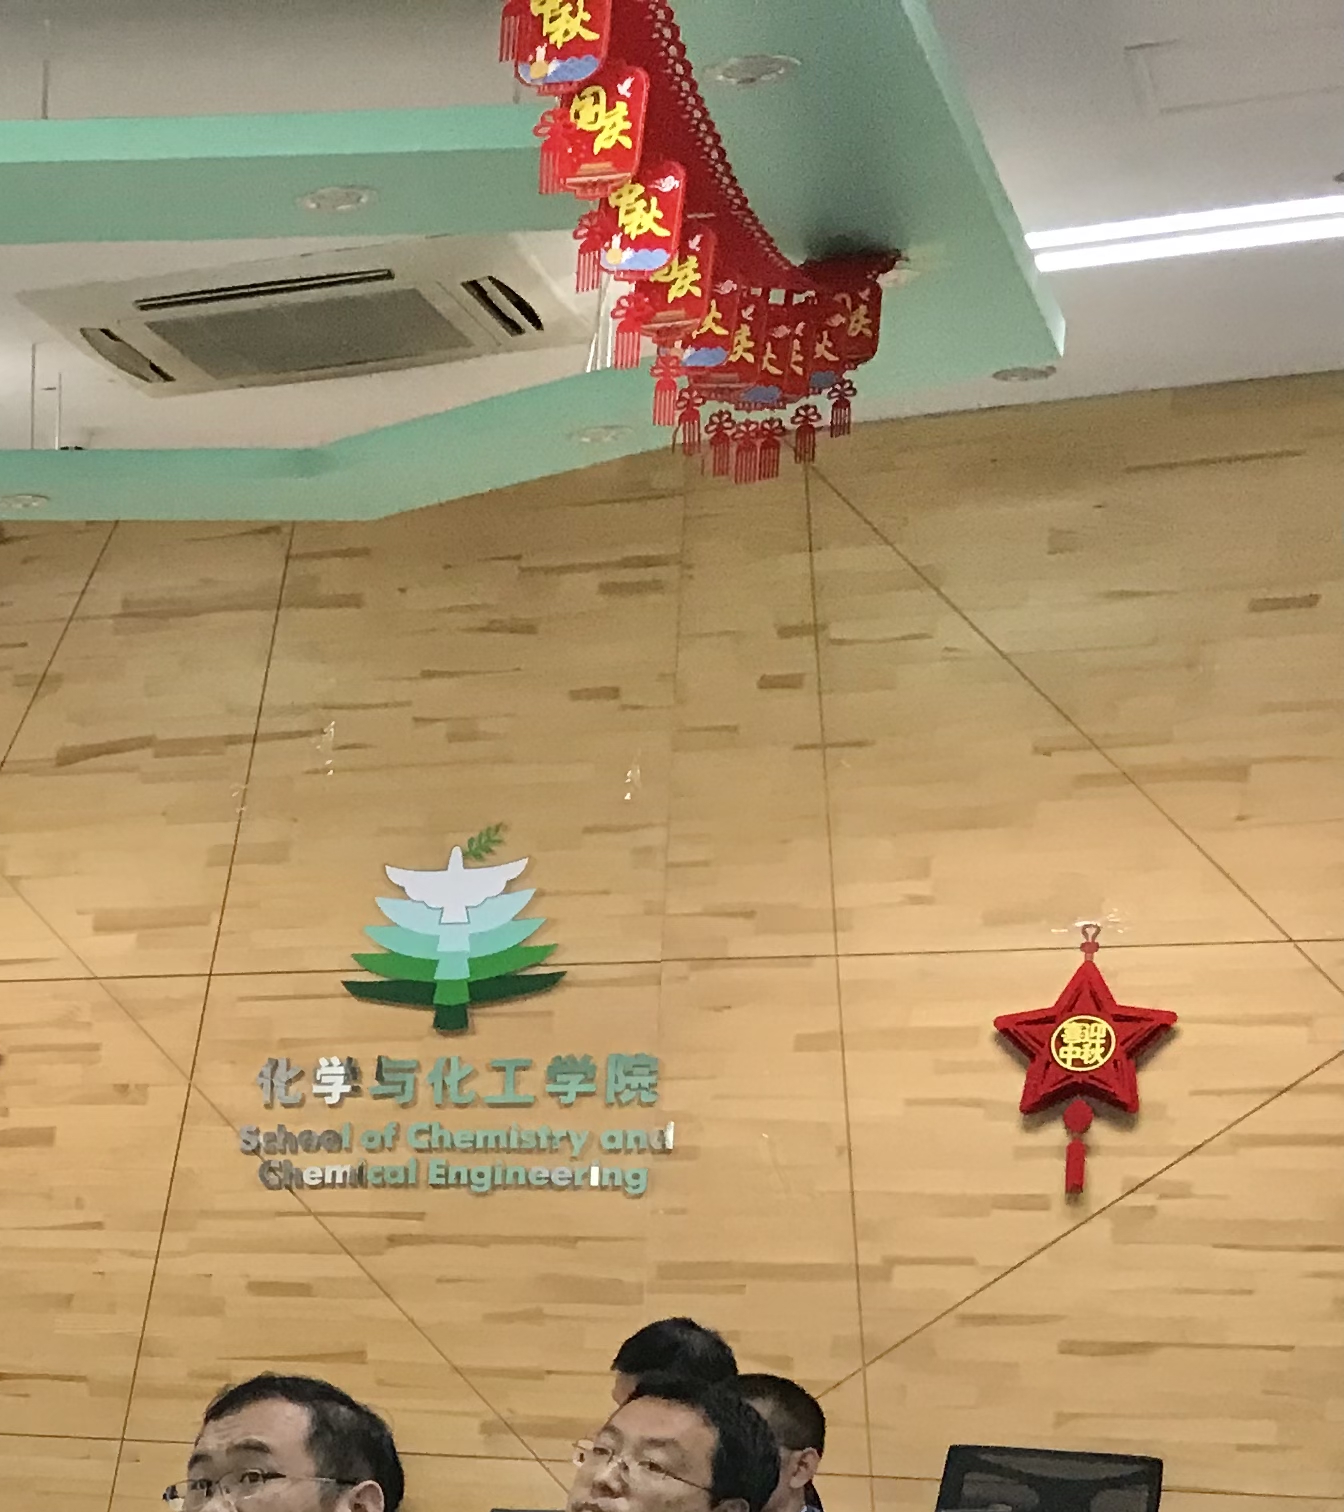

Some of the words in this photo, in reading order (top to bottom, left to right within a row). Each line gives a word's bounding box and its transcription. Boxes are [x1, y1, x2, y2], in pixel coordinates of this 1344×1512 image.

[570, 86, 632, 155] 国庆
[257, 1053, 659, 1107] 化学与化工学院
[240, 1122, 351, 1155] School
[360, 1121, 399, 1151] of
[407, 1121, 590, 1157] Chemistry
[601, 1121, 675, 1151] and
[258, 1159, 417, 1190] Chemical
[429, 1159, 649, 1196] Engineering
